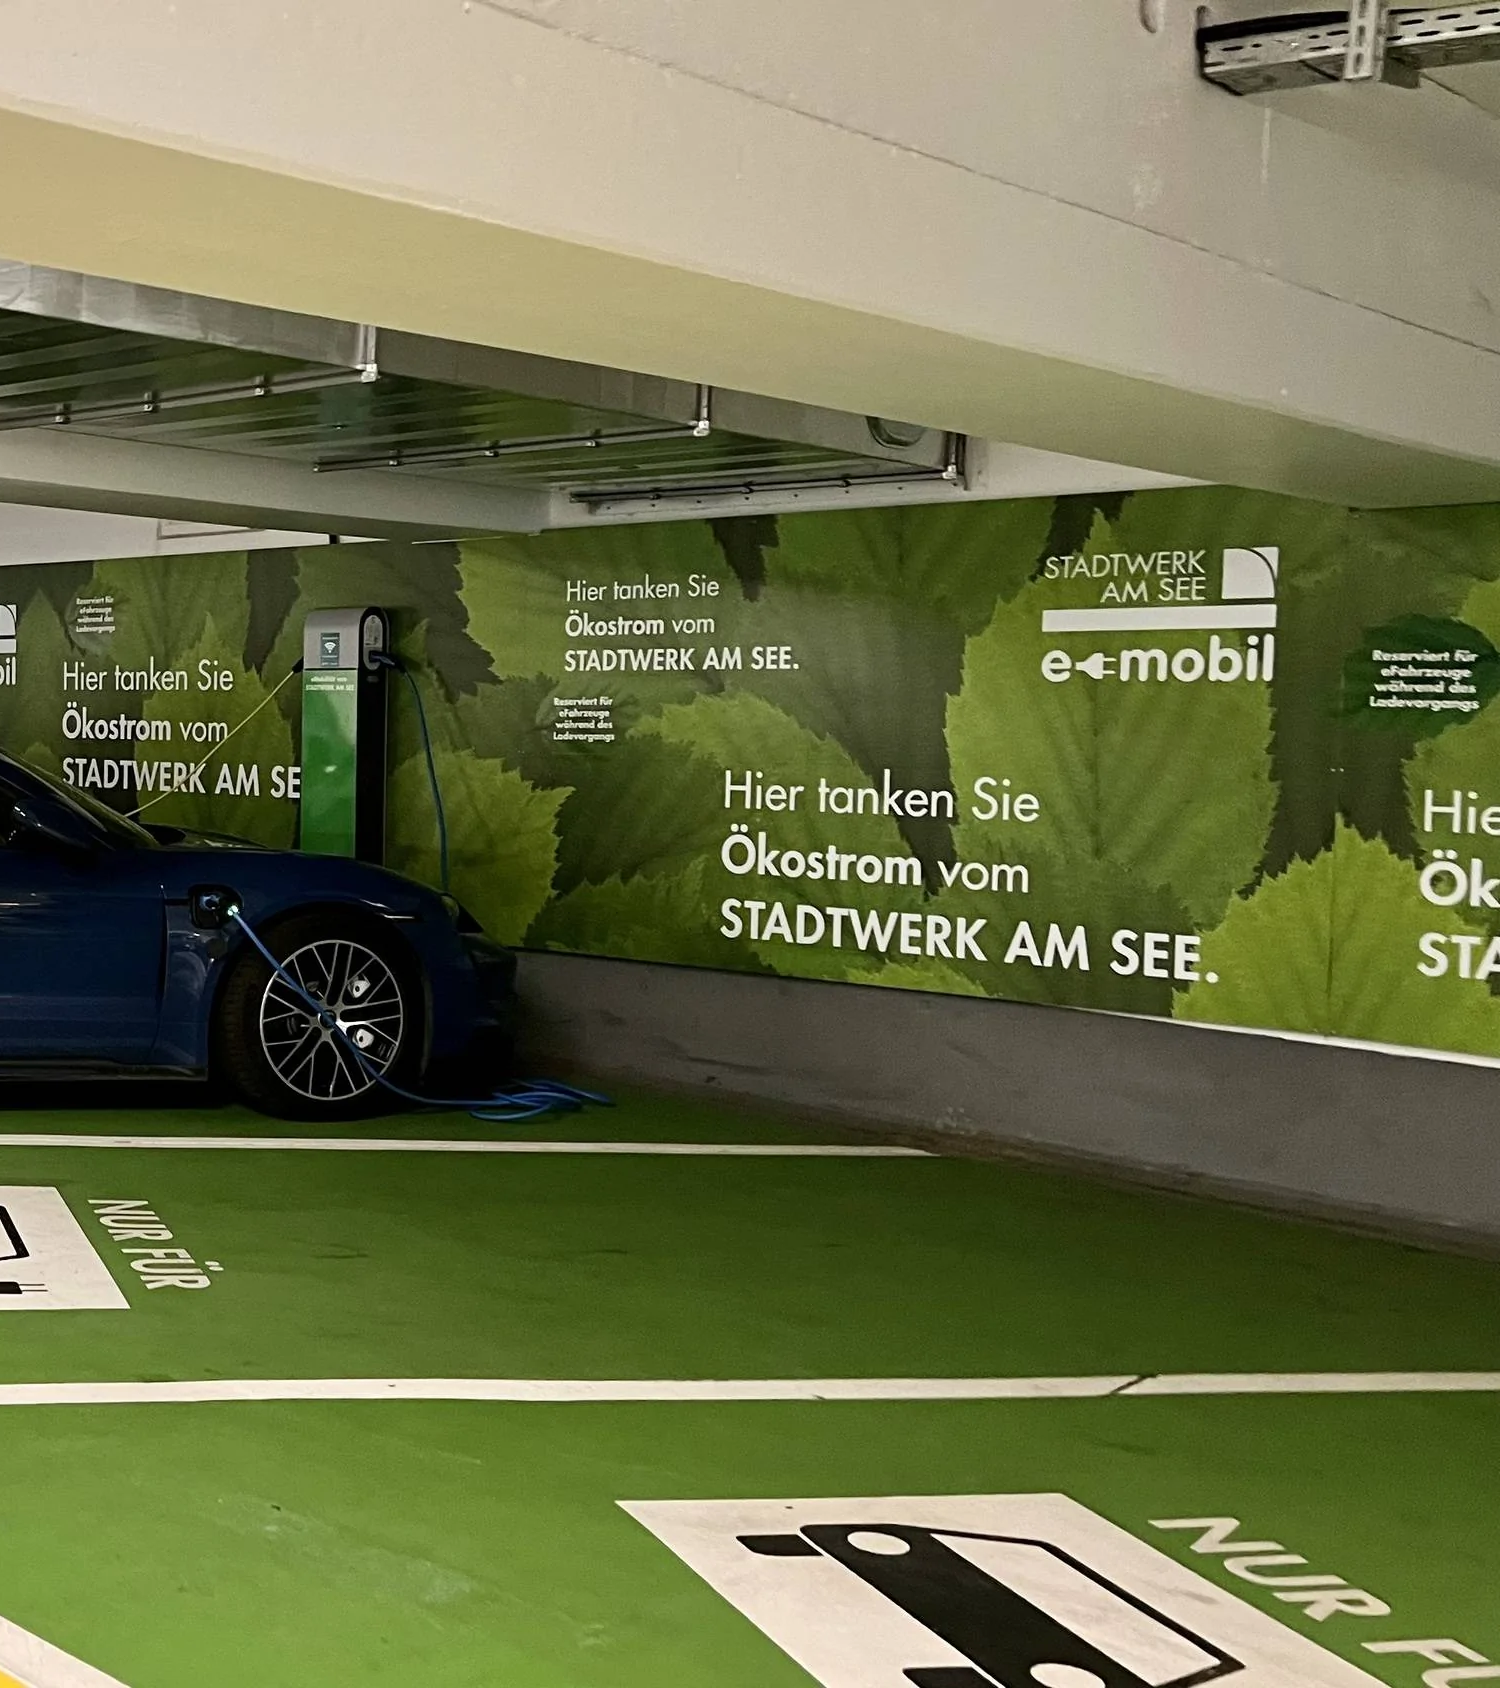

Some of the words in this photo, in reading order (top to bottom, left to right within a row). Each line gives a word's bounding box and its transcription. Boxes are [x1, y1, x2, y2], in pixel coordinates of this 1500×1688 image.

[1045, 550, 1206, 579] STADTWERK
[566, 579, 607, 602] Hier
[613, 574, 680, 600] tanken
[687, 573, 720, 597] Sie
[1100, 581, 1148, 603] AM
[1158, 577, 1206, 601] SEE
[564, 609, 665, 637] Ökostrom
[671, 617, 715, 634] vom
[564, 648, 696, 673] STADTWERK
[702, 646, 743, 671] AM
[750, 645, 800, 670] SEE.
[1372, 649, 1450, 662] Reserviert
[1454, 649, 1480, 662] für
[1381, 664, 1473, 681] eFahrzeuge
[62, 661, 108, 691] Hier
[114, 656, 188, 691] tanken
[197, 659, 234, 691] Sie
[1374, 680, 1445, 693] während
[1448, 681, 1477, 694] des
[1369, 694, 1480, 712] Ladevorgangs
[62, 701, 172, 741] Ökostrom
[179, 721, 228, 742] vom
[62, 757, 207, 794] STADTWERK
[214, 763, 260, 797] AM
[270, 765, 301, 799] SE
[722, 769, 805, 812] Hier
[818, 768, 954, 818] tanken
[971, 775, 1041, 823] Sie
[720, 823, 923, 886] Ökostrom
[937, 858, 1030, 893] vom
[1419, 849, 1500, 909] Ök
[719, 897, 989, 962] STADTWERK
[1002, 920, 1091, 972] AM
[1108, 928, 1220, 985] SEE.
[87, 1199, 174, 1242] NUR
[120, 1248, 225, 1290] FÜR
[1147, 1517, 1392, 1622] NUR
